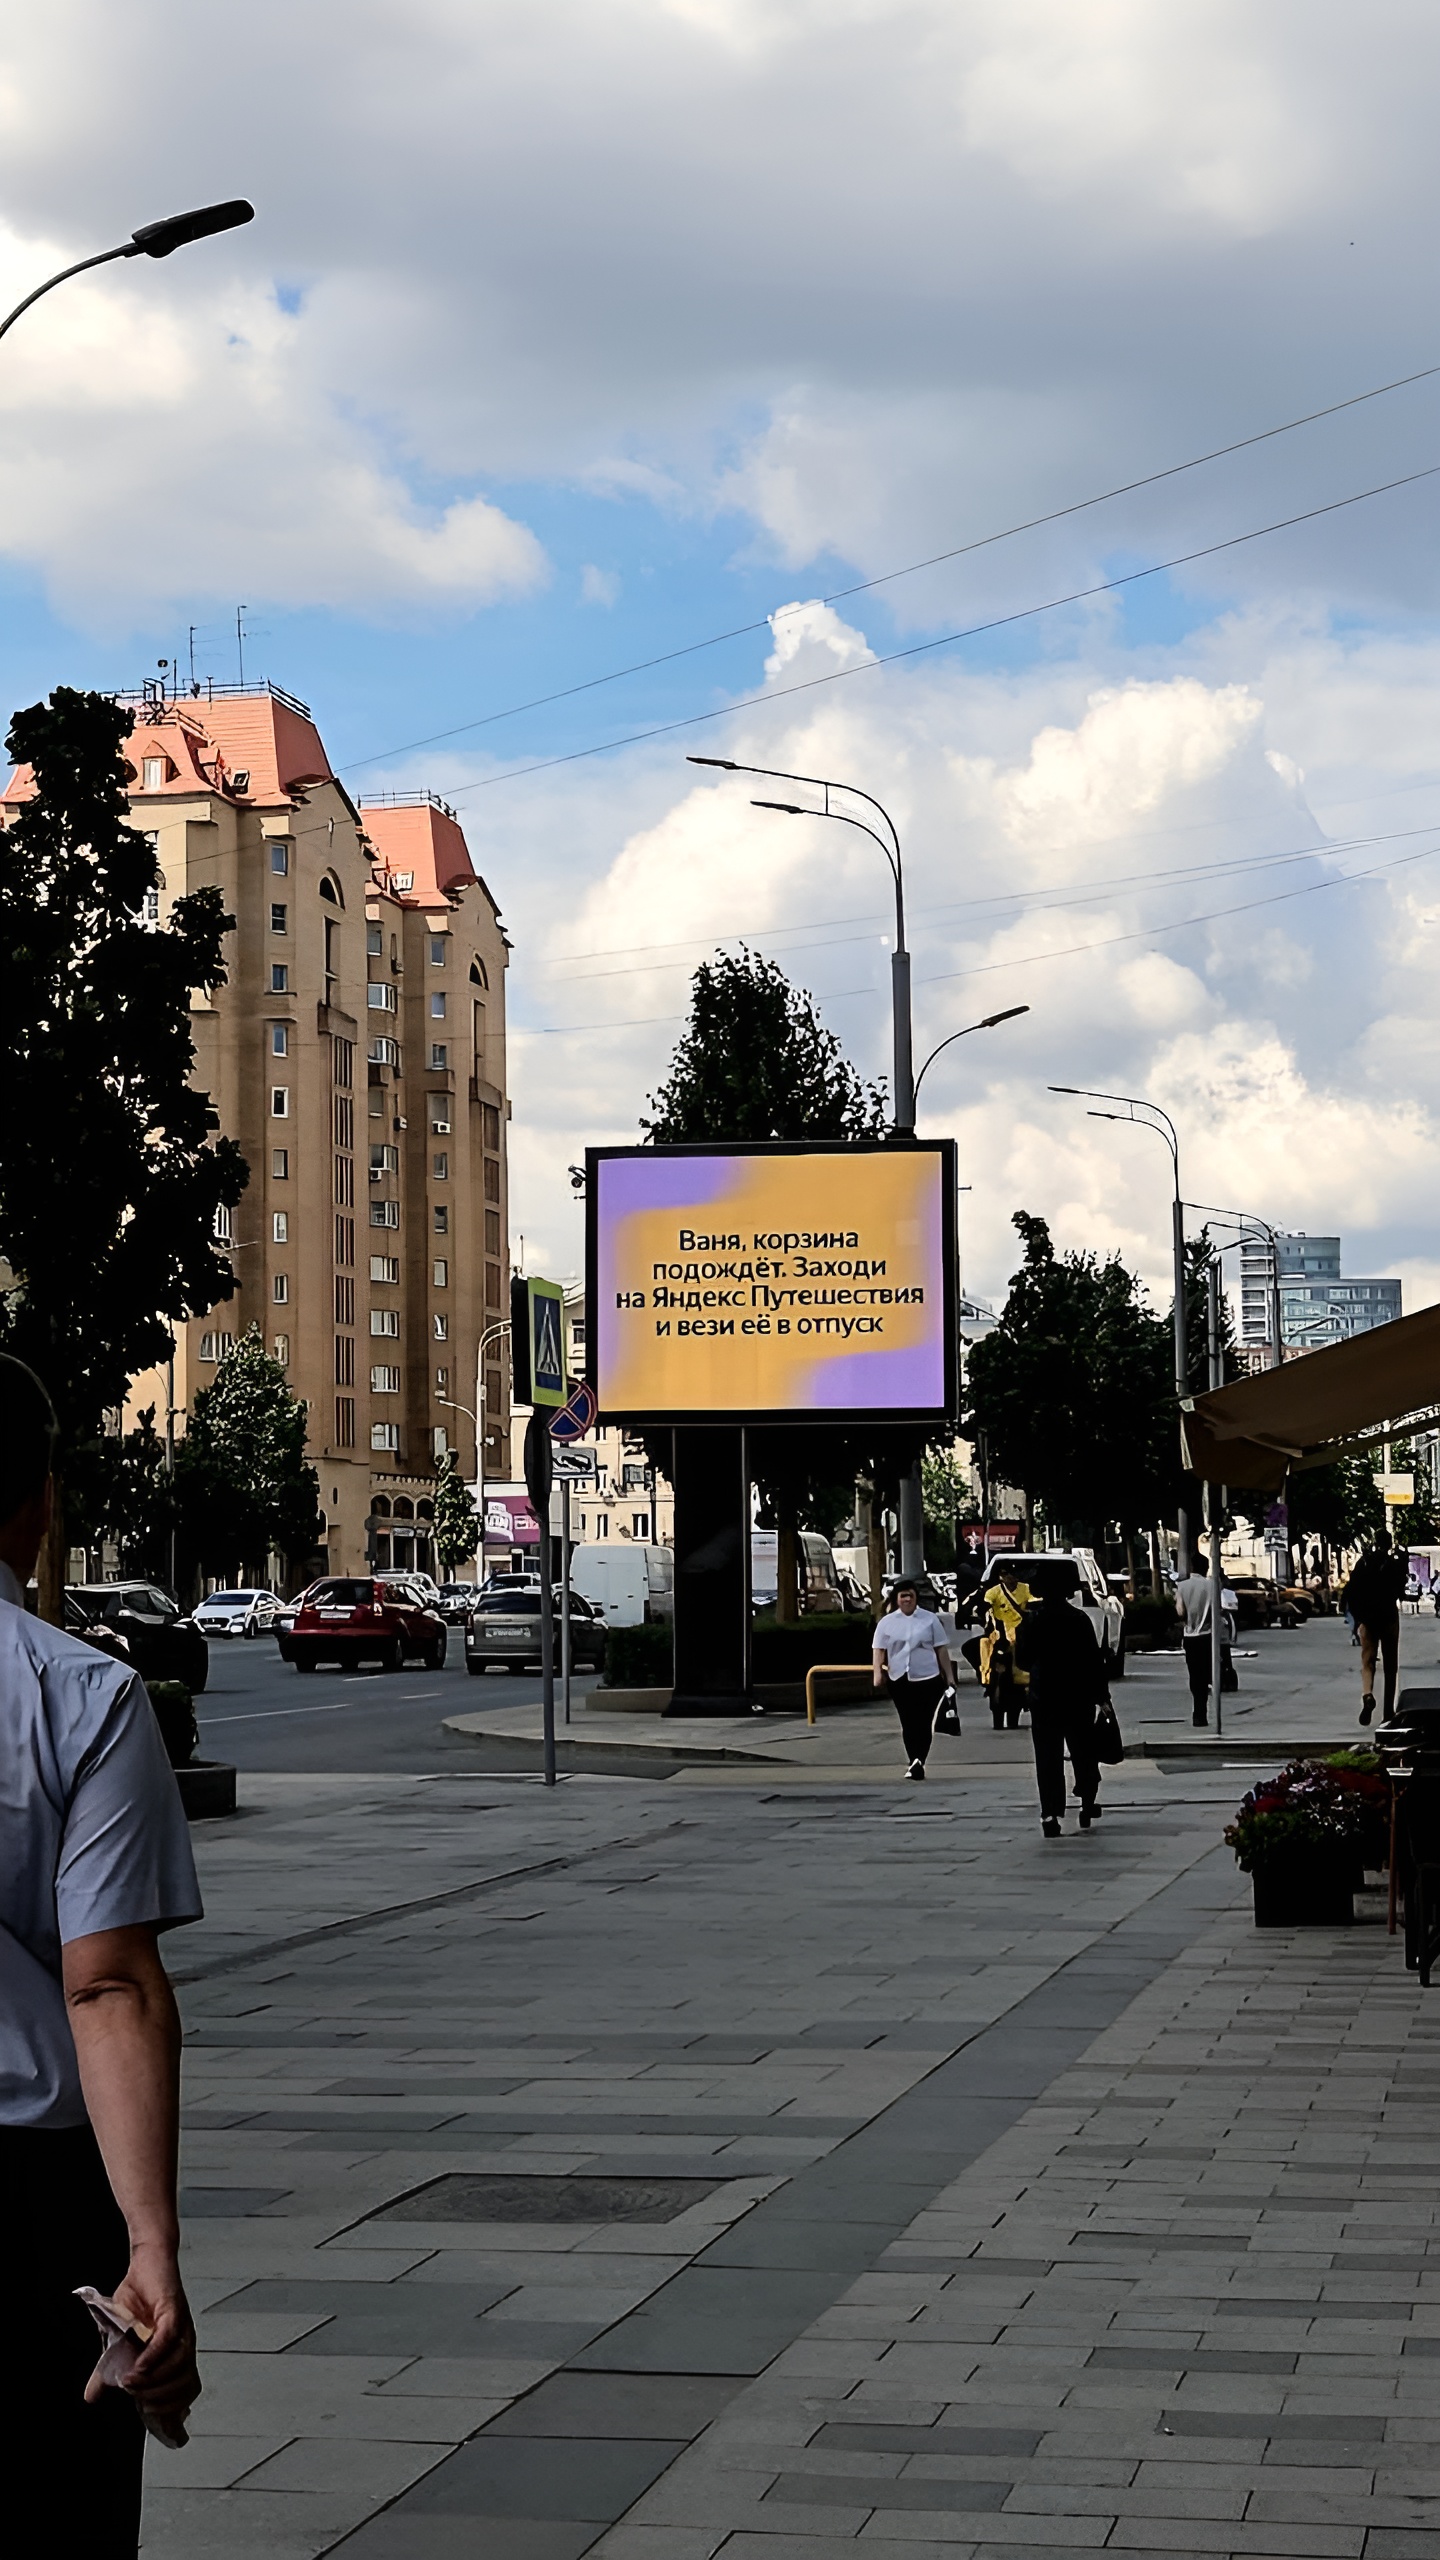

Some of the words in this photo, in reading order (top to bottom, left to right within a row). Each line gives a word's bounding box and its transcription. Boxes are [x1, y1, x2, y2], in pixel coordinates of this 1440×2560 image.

[680, 1230, 746, 1252] Ваня,
[754, 1232, 858, 1253] корзина
[654, 1258, 786, 1284] подождёт.
[793, 1257, 886, 1280] Заходи
[617, 1292, 645, 1308] на
[653, 1287, 745, 1311] Яндекс
[752, 1285, 923, 1311] Путешествия
[657, 1321, 670, 1335] и
[678, 1320, 734, 1335] вези
[742, 1314, 770, 1334] её
[778, 1319, 790, 1334] в
[798, 1317, 883, 1338] отпуск
